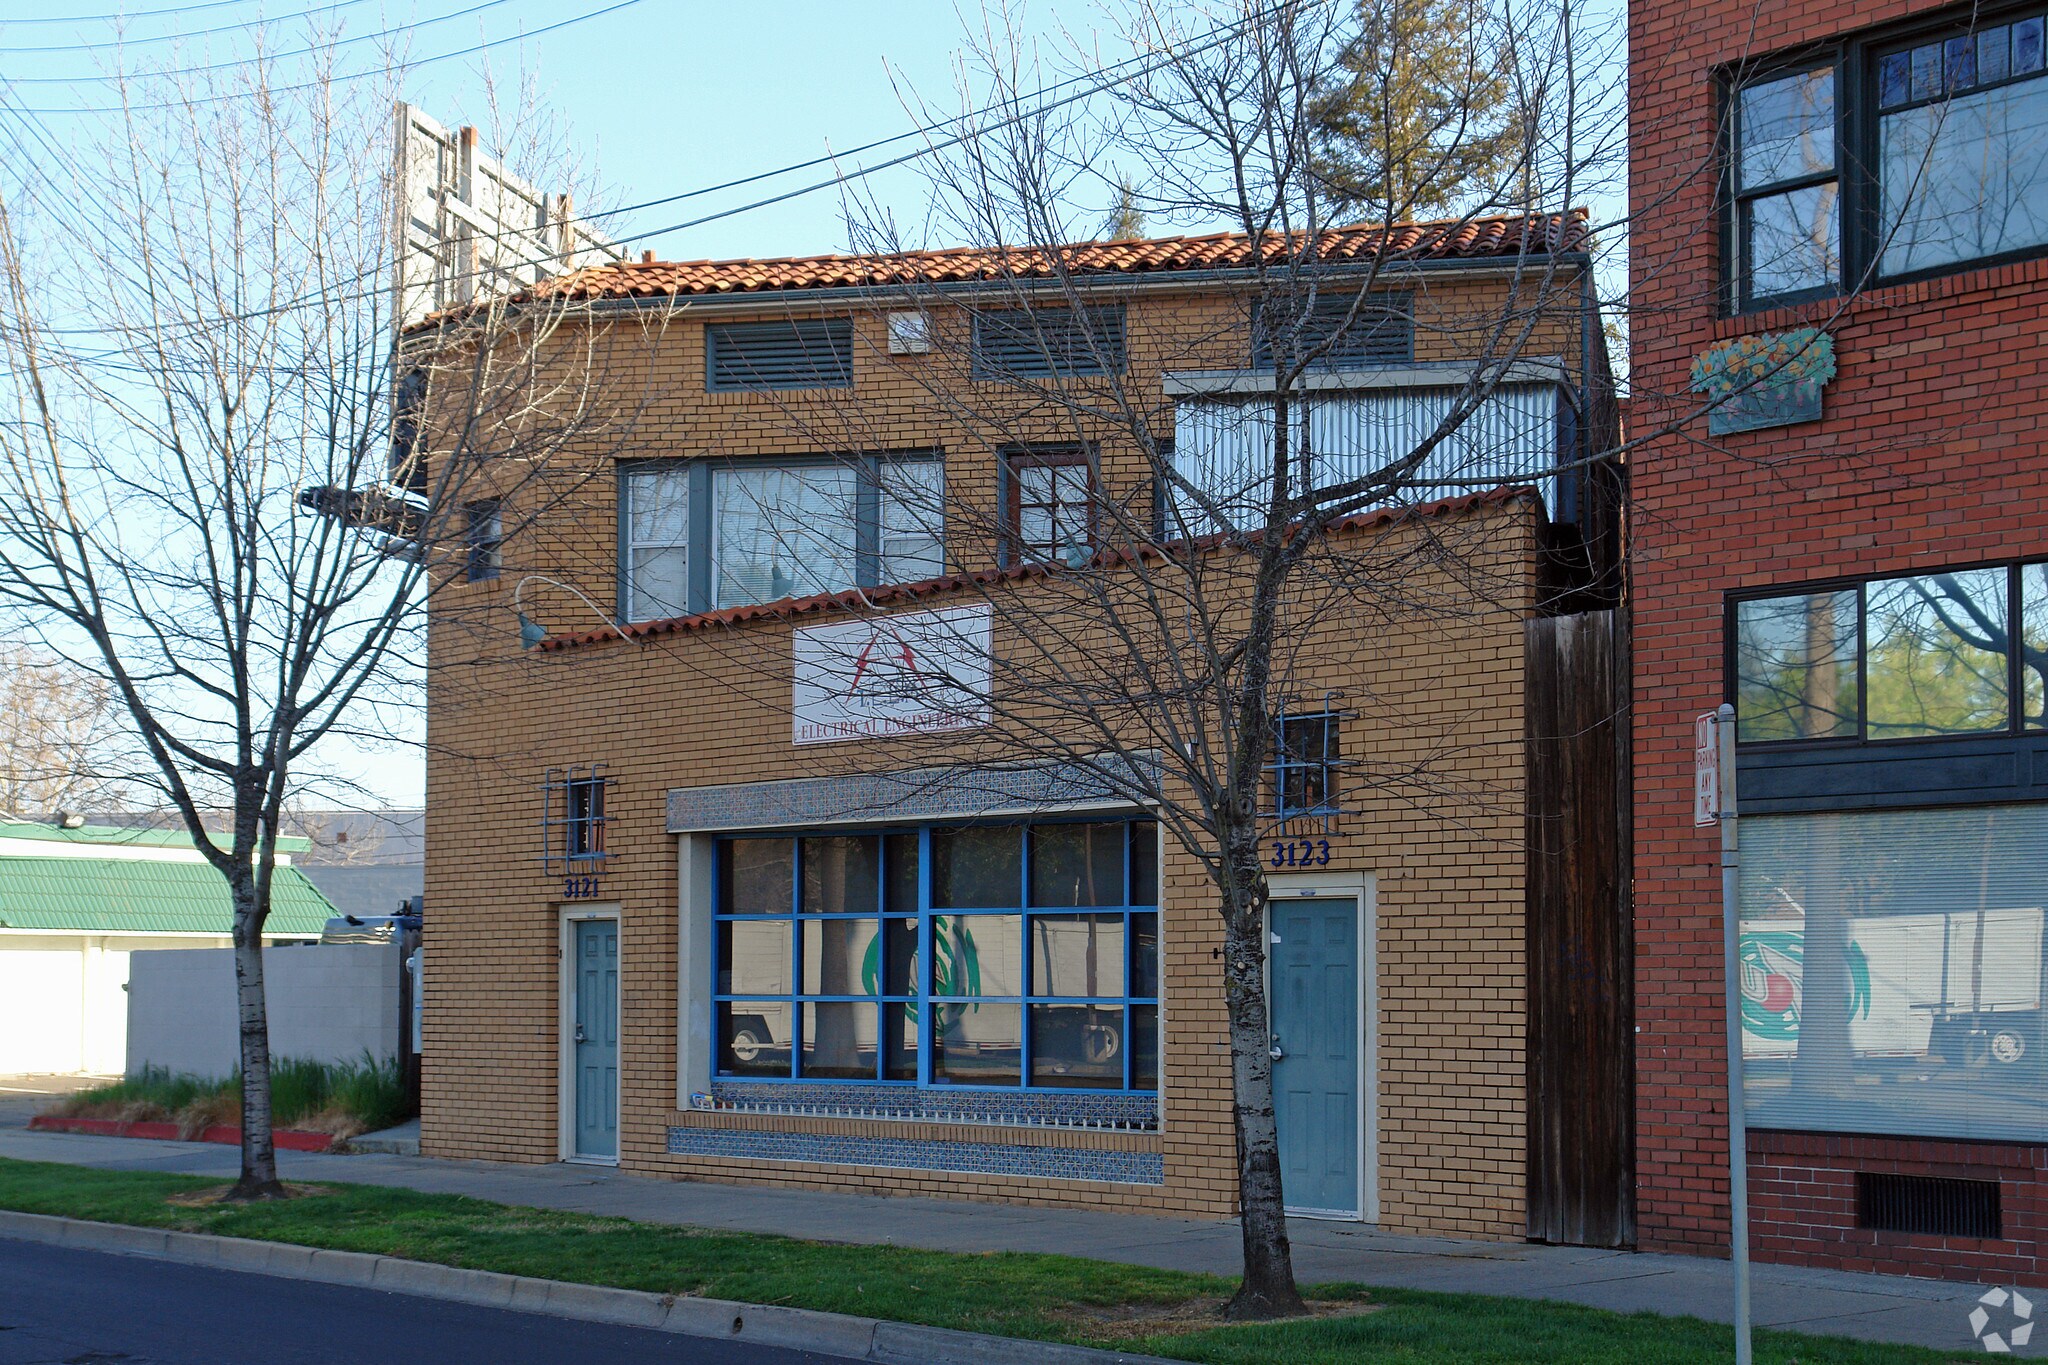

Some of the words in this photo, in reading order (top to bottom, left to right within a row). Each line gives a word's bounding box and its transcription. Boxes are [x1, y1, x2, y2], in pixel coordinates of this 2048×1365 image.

[802, 719, 879, 739] ELECTRICAL
[1271, 840, 1330, 867] 3123
[564, 877, 598, 897] 3121
